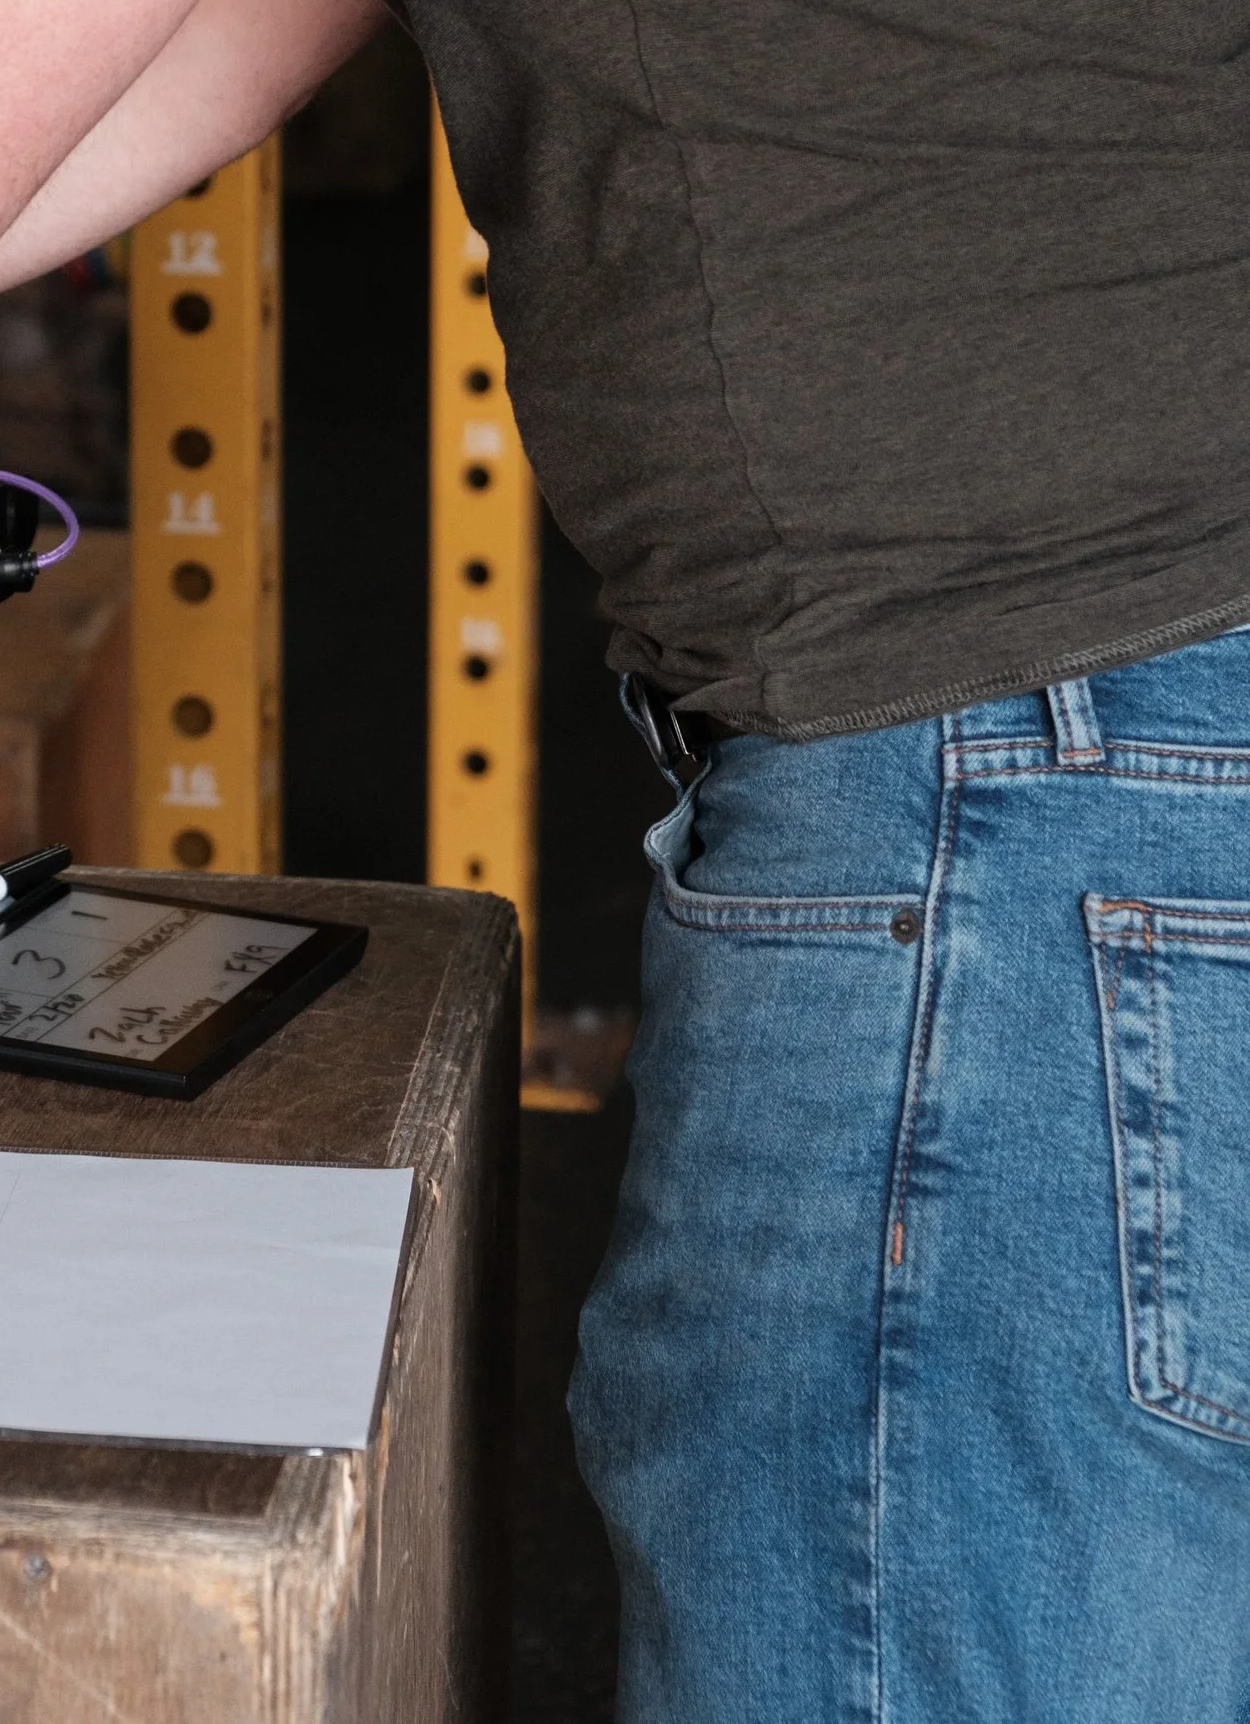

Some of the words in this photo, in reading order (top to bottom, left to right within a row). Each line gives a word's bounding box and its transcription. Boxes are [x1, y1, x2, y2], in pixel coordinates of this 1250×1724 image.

[166, 231, 220, 268] 12
[166, 492, 218, 528] 14
[12, 948, 67, 980] 3
